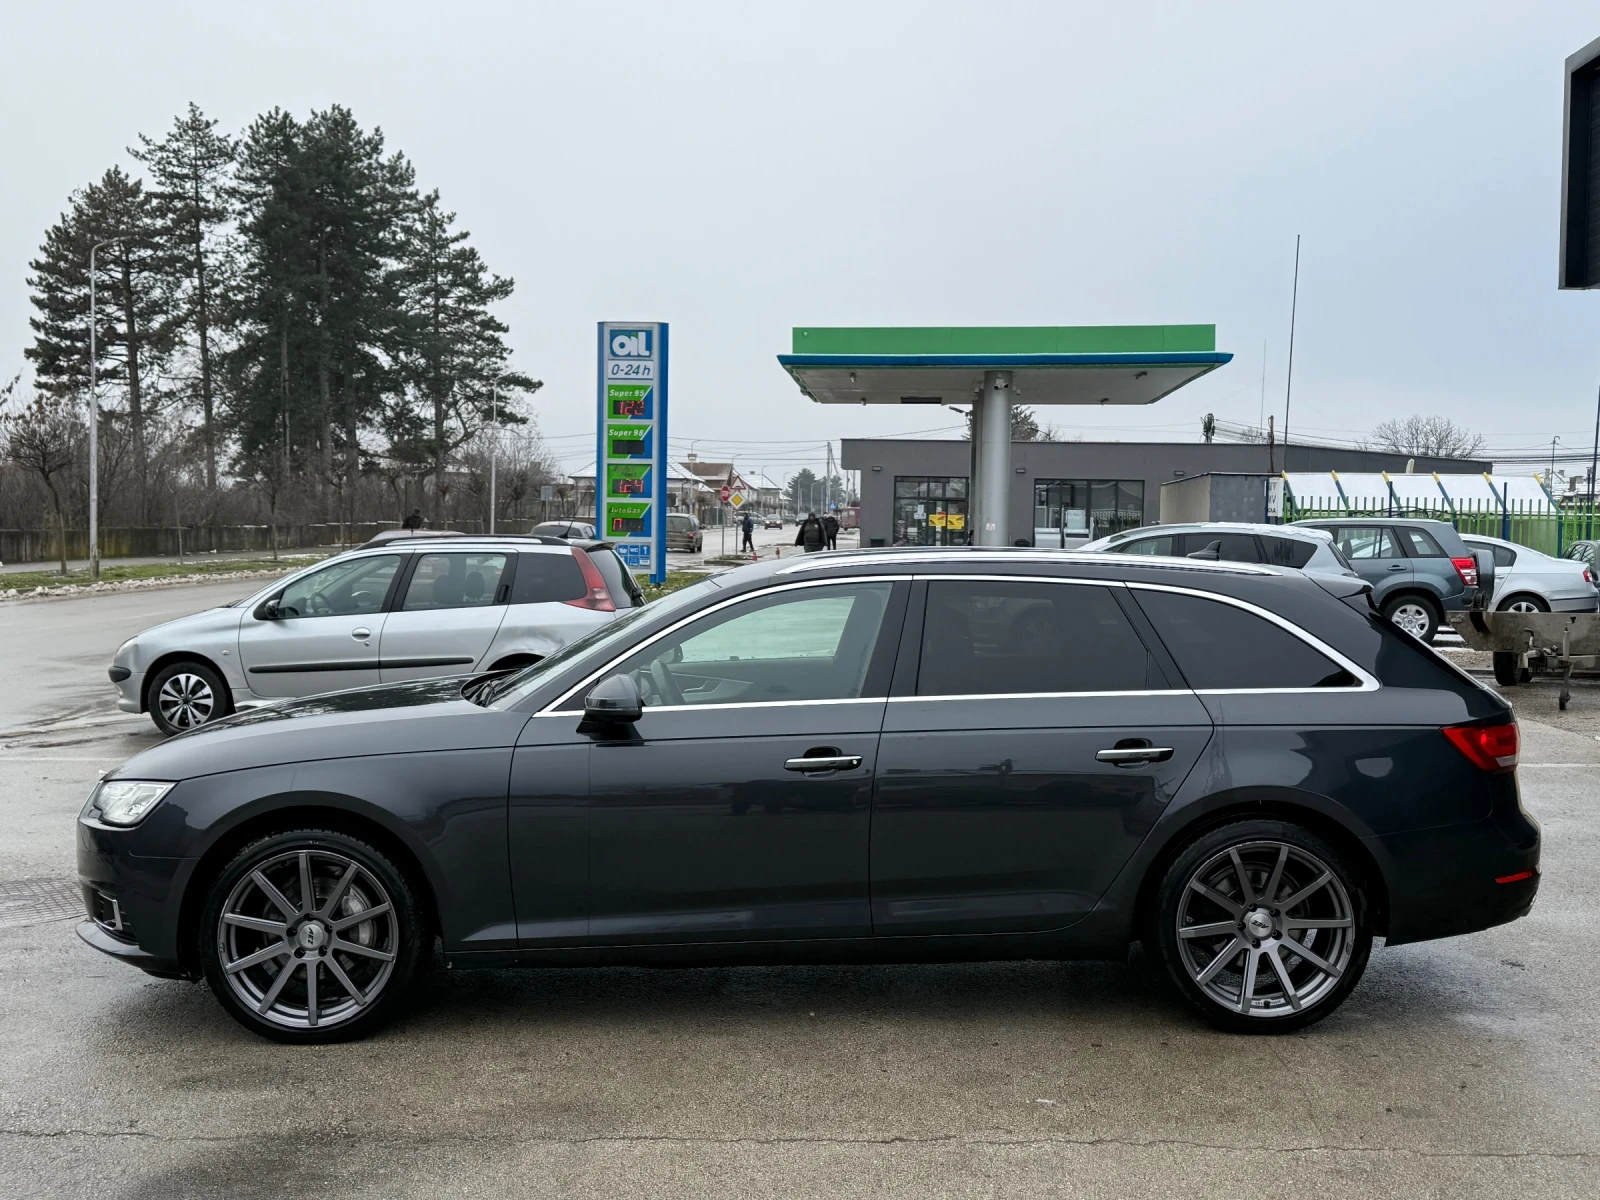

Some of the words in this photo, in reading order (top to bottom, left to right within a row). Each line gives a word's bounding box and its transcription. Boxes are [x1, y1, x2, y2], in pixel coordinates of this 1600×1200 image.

[611, 364, 641, 376] 0-24
[642, 365, 651, 376] h
[609, 389, 633, 398] Super
[634, 389, 645, 397] 95
[608, 429, 632, 438] Super
[633, 429, 645, 437] 98
